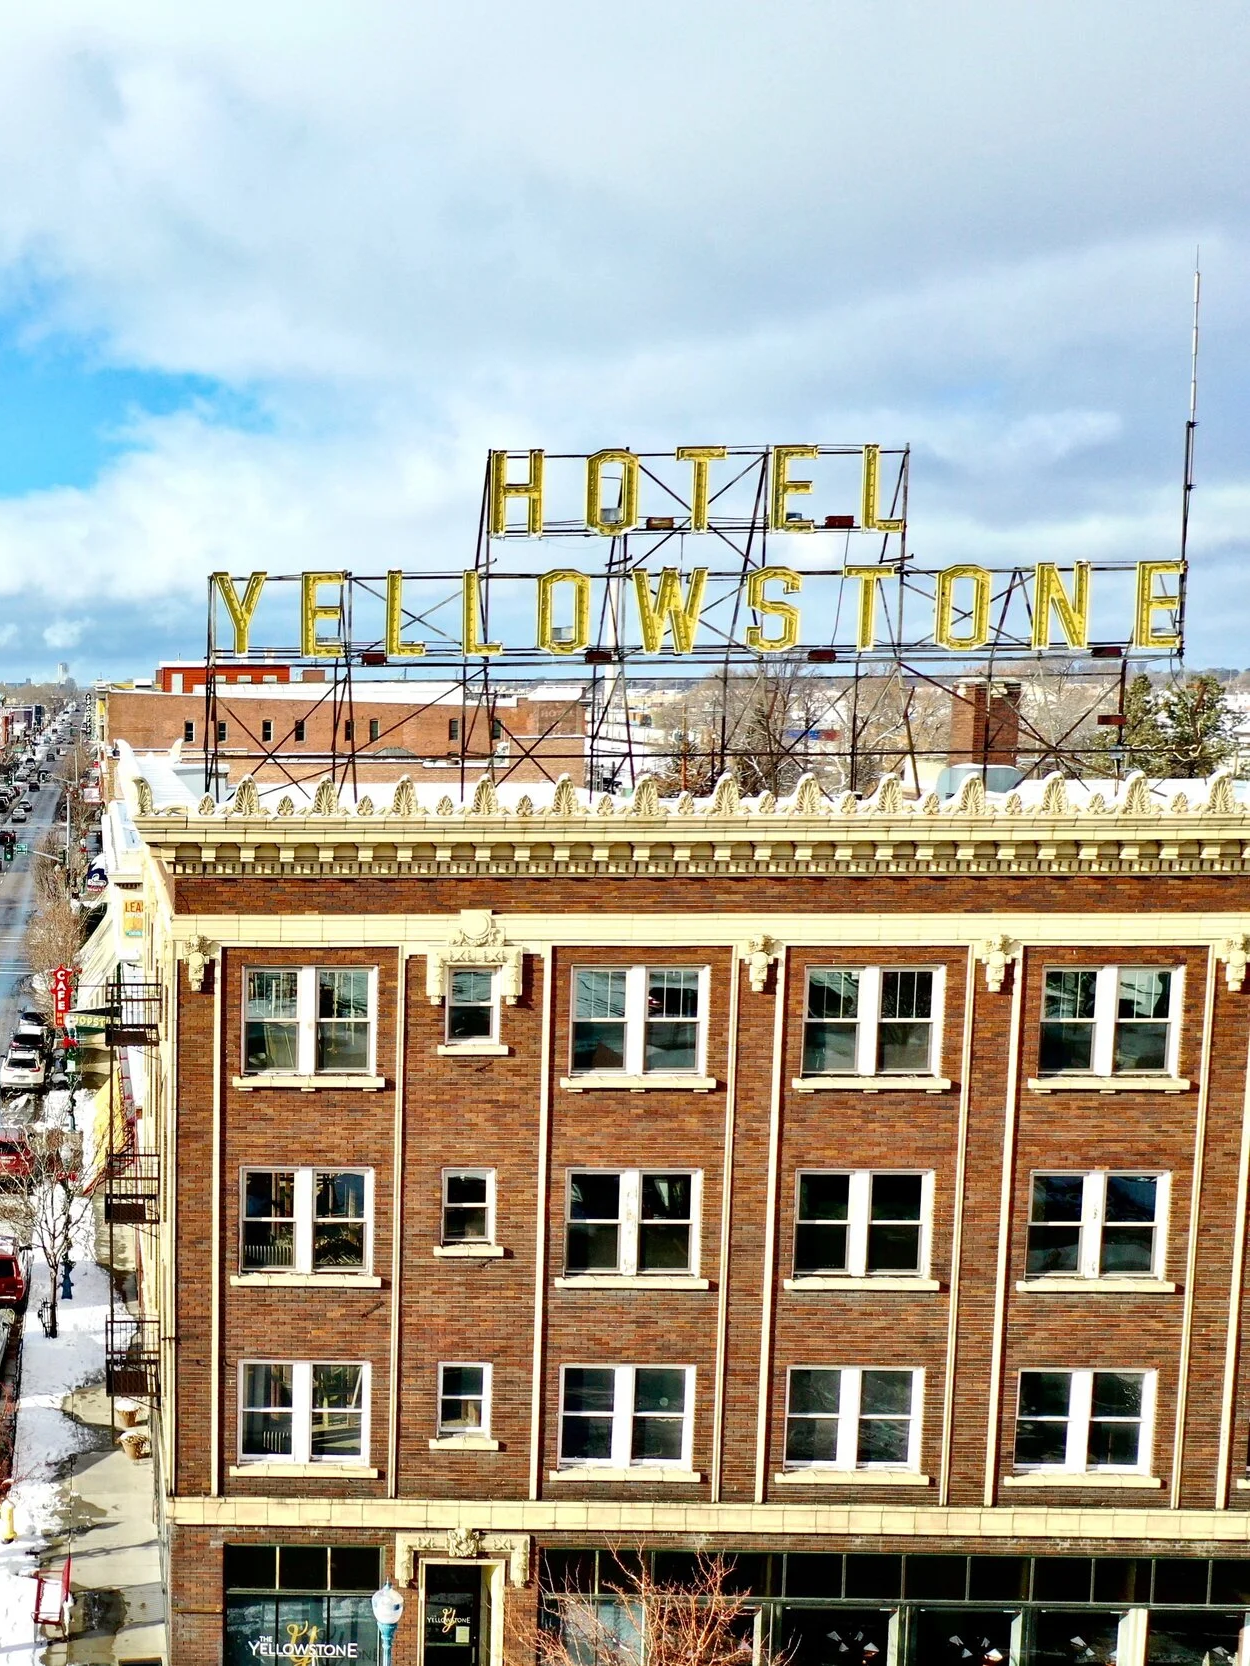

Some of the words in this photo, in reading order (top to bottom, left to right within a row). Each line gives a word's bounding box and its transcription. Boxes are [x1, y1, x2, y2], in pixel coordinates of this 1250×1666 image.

[490, 444, 904, 540] HOTEL
[212, 559, 1187, 658] YELLOWSTONE
[125, 901, 143, 913] LEA
[56, 970, 67, 1011] CAFE
[247, 1641, 358, 1658] YELLOWSTONE
[259, 1635, 273, 1643] THE
